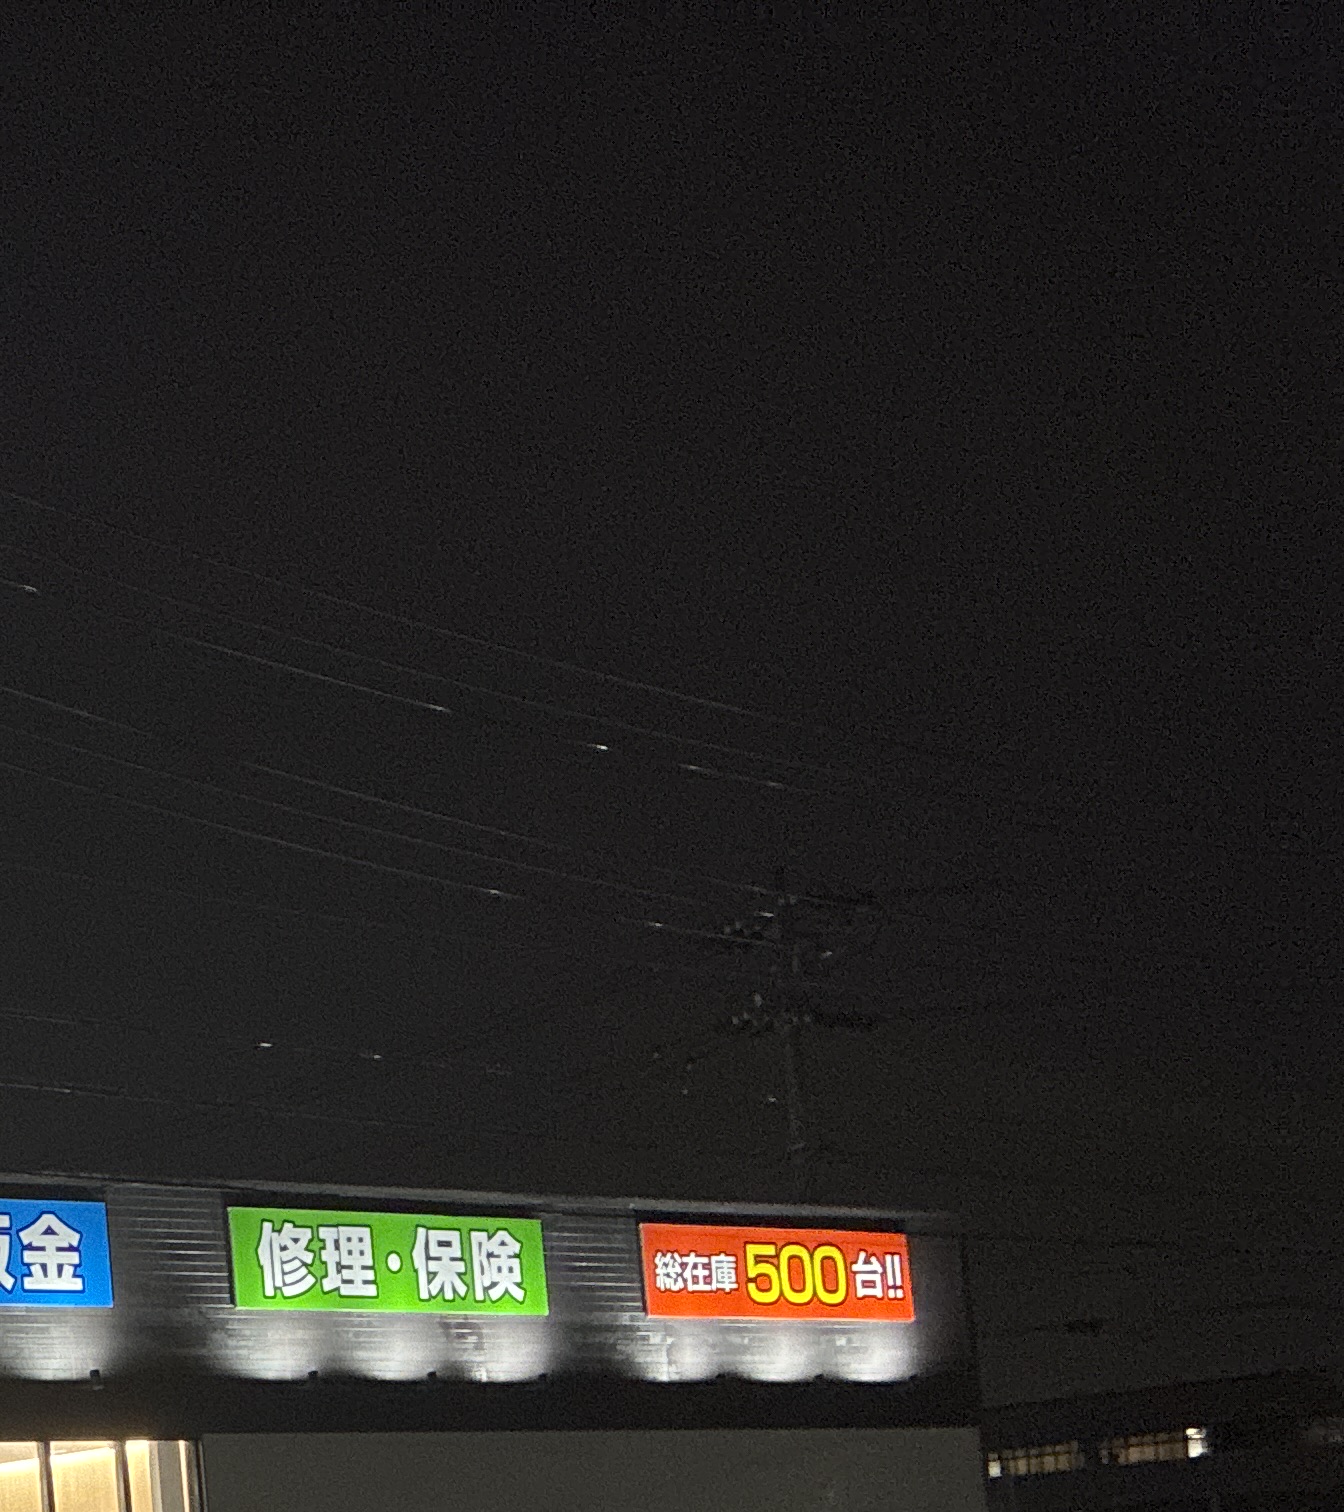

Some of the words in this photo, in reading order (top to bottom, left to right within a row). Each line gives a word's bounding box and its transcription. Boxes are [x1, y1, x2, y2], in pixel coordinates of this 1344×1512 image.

[257, 1220, 526, 1302] 修理・保険
